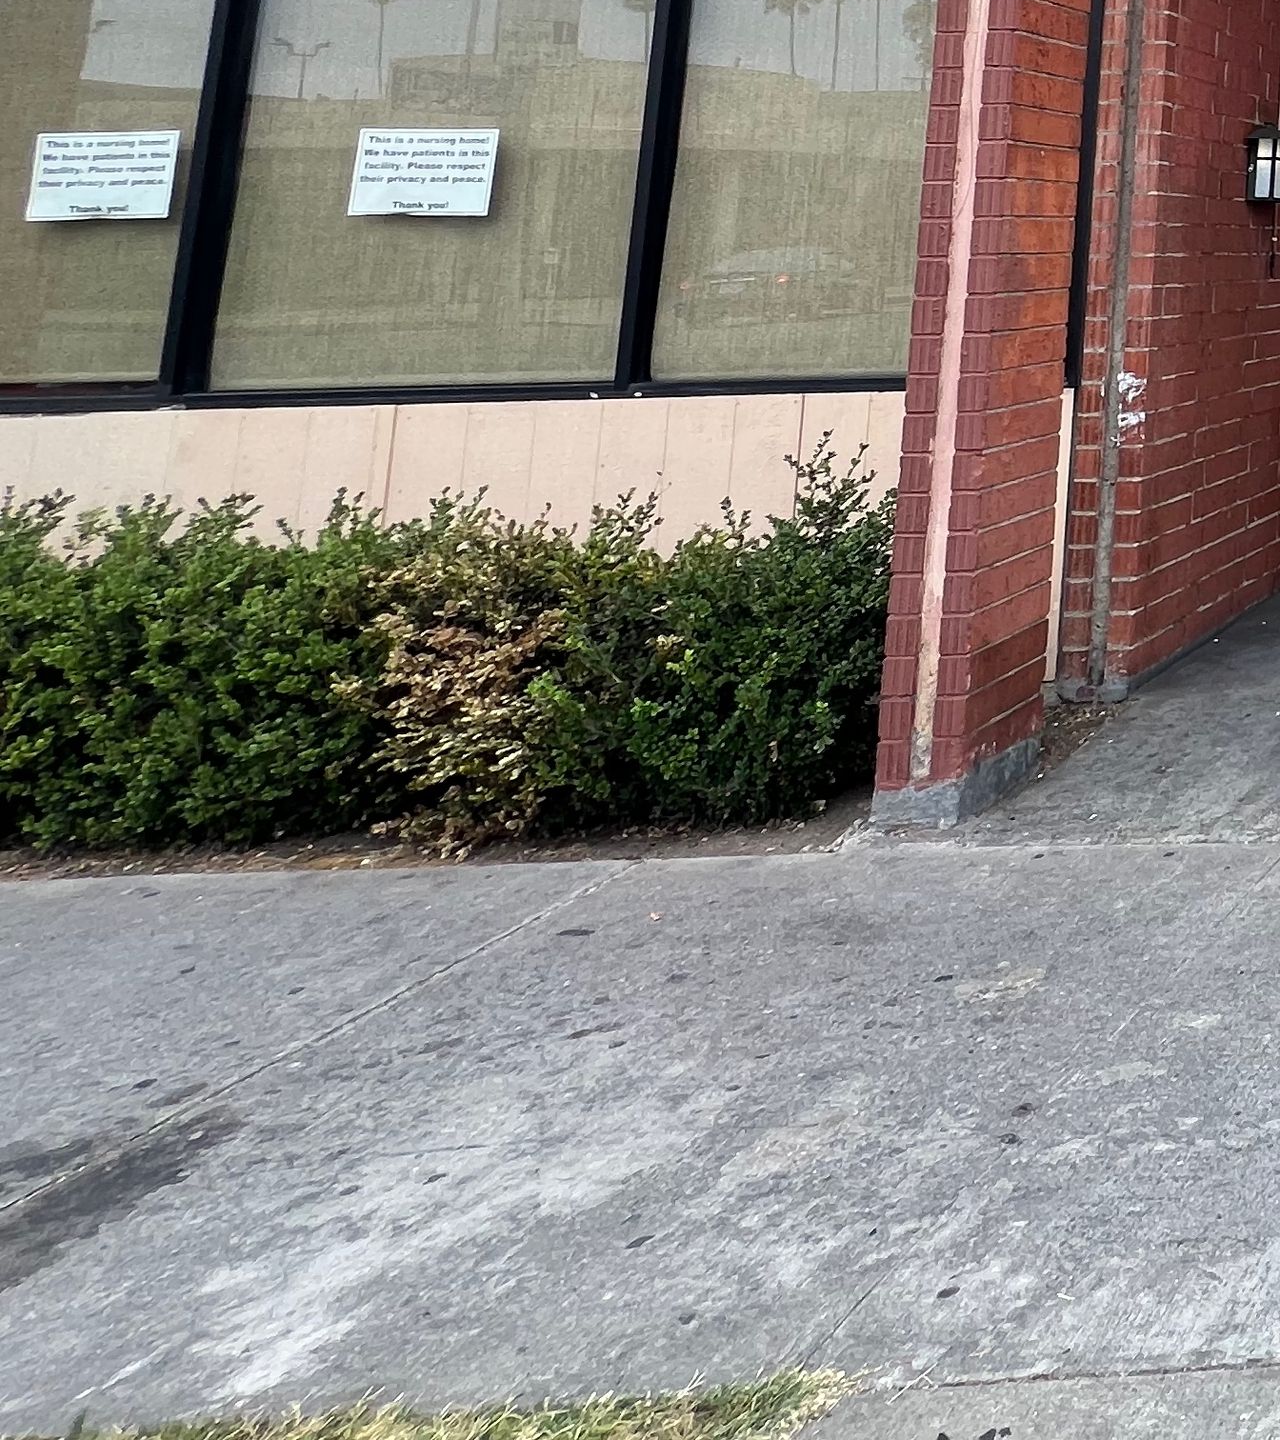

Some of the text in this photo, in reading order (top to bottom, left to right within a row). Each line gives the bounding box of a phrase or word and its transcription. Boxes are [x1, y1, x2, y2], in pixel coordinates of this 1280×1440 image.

[369, 135, 391, 144] This
[395, 136, 403, 144] is
[417, 137, 456, 145] nursing
[364, 149, 489, 158] We have patients in this
[408, 162, 443, 170] Please
[447, 162, 485, 171] respect
[360, 175, 384, 183] their
[387, 176, 426, 184] privacy
[430, 175, 448, 183] and
[392, 201, 423, 209] Thank
